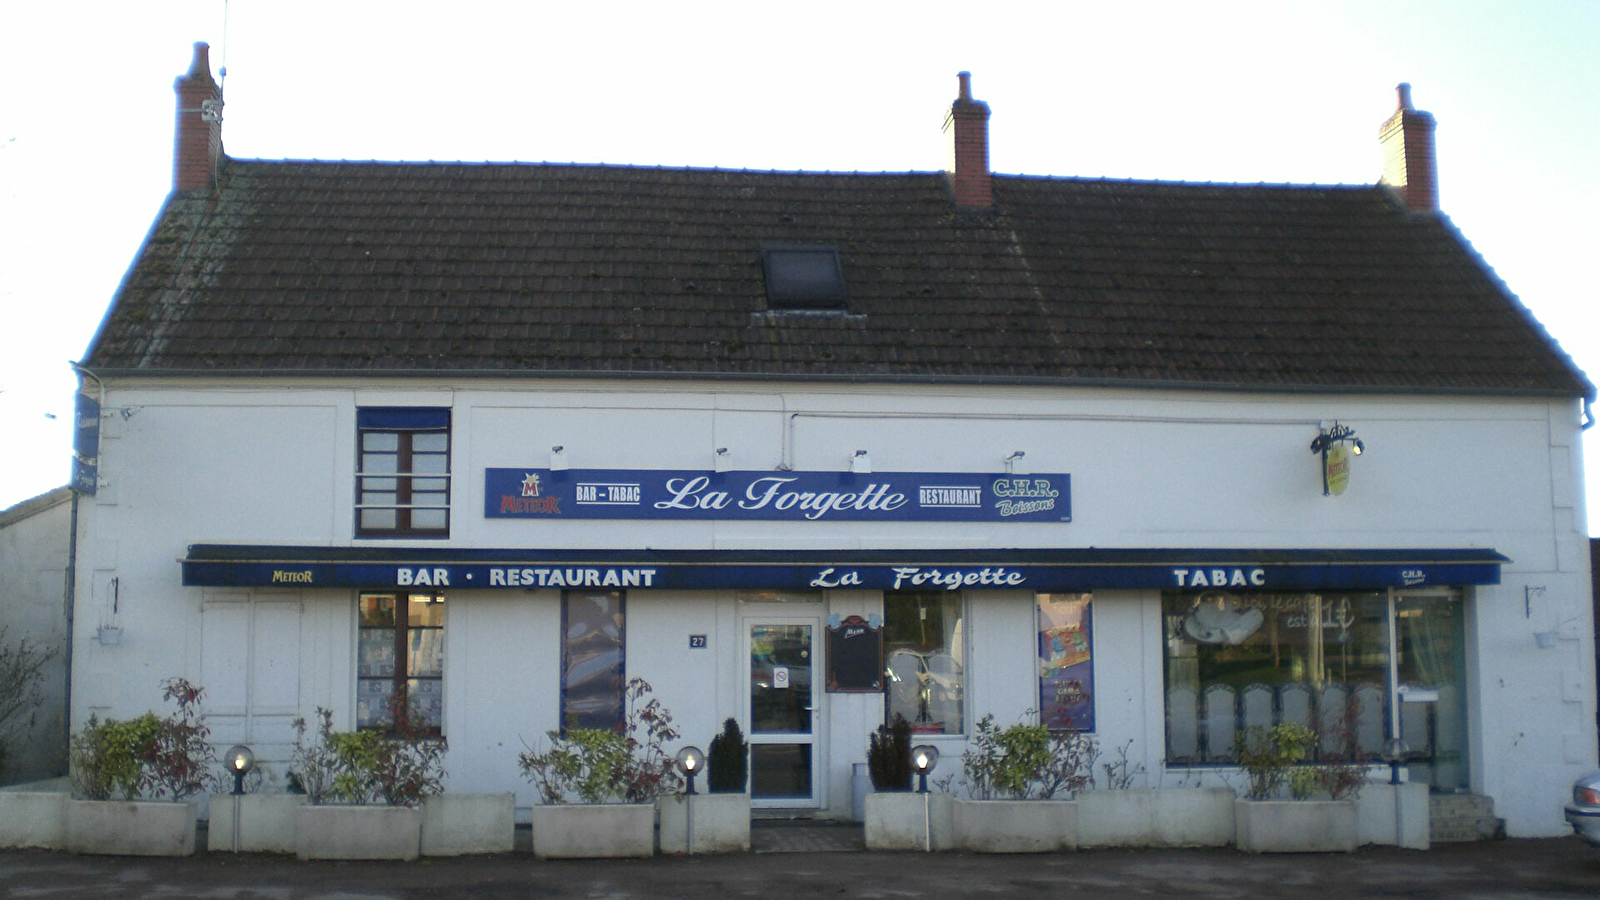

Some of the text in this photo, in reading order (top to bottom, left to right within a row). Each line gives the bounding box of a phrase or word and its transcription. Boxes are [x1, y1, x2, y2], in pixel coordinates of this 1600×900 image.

[576, 486, 596, 501] BAR
[608, 486, 640, 502] TABAC
[654, 476, 909, 520] La Forgette
[920, 489, 982, 505] RESTAURANT
[993, 479, 1059, 498] C.H.R.
[501, 495, 561, 514] METEOR
[995, 498, 1055, 517] Boissons
[272, 570, 313, 583] METEOR
[397, 568, 656, 587] BAR RESTAURANT
[809, 567, 1027, 590] La Forgette
[1173, 569, 1265, 586] TABAC
[692, 637, 704, 647] 27
